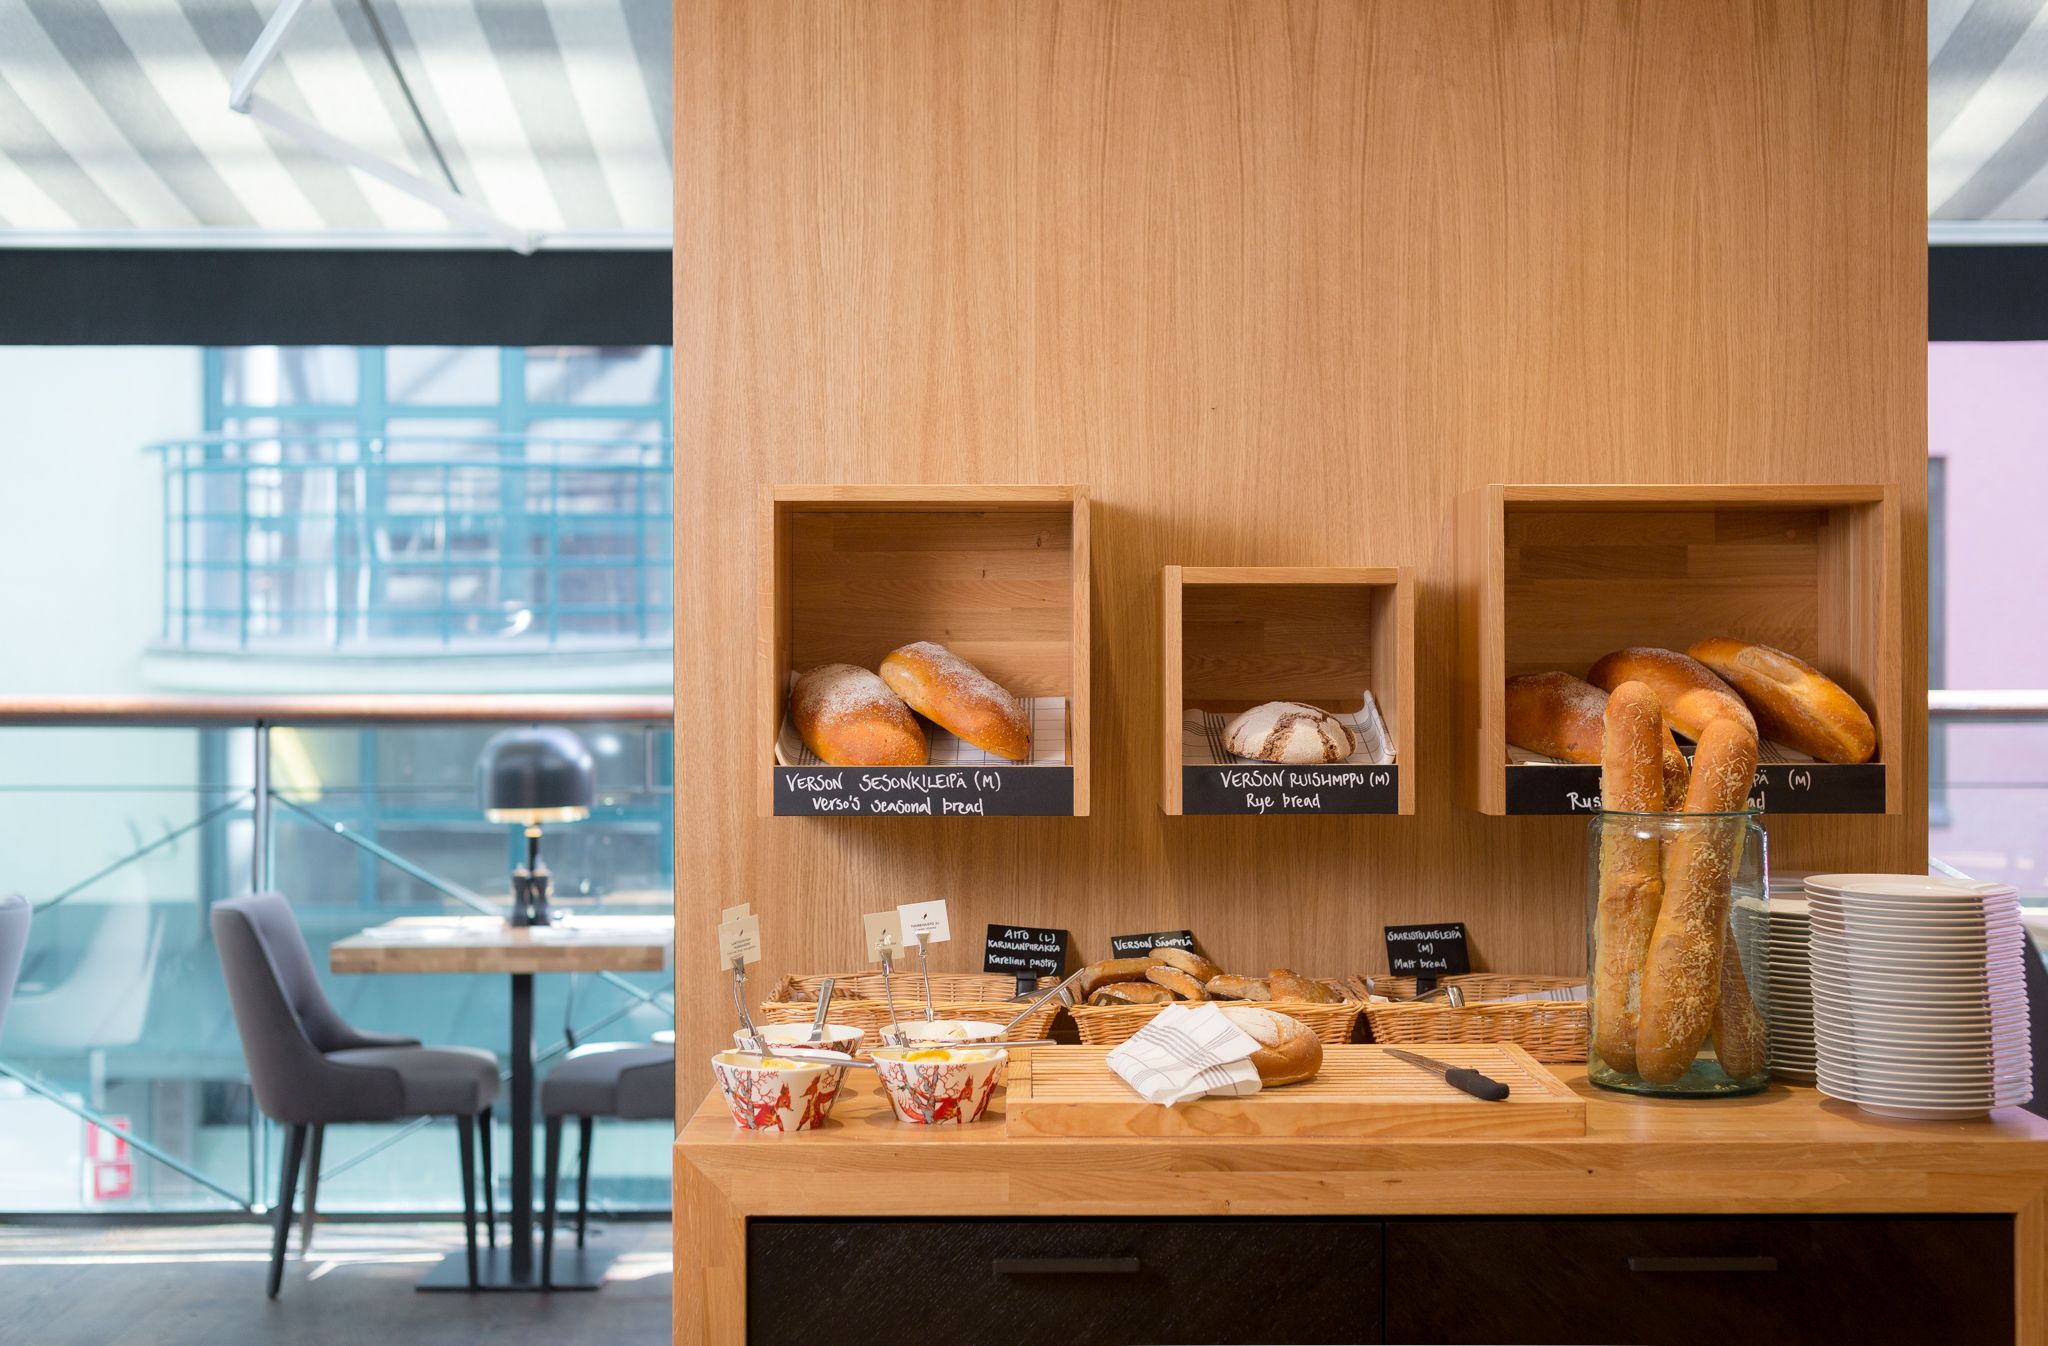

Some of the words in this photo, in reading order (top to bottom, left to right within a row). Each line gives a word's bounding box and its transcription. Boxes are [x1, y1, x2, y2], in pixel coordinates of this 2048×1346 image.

[785, 771, 843, 792] VERSON
[859, 771, 967, 793] SESONKILEIPÄ
[974, 771, 1001, 792] (M)
[1220, 769, 1285, 788] VERSON
[1369, 772, 1390, 787] (M)
[1788, 769, 1811, 791] (M)
[943, 797, 984, 816] bread
[1246, 793, 1274, 814] Rye
[1282, 793, 1321, 808] bread
[1566, 792, 1602, 810] Rus
[1004, 929, 1029, 940] AITO
[1039, 933, 1056, 944] (L)
[1113, 936, 1152, 951] VERSON
[987, 940, 1061, 953] KARJALANPIIRAKKA
[1417, 942, 1434, 955] (M)
[988, 954, 1026, 966] Karelian
[1029, 957, 1058, 975] pastry
[1420, 957, 1448, 970] bread
